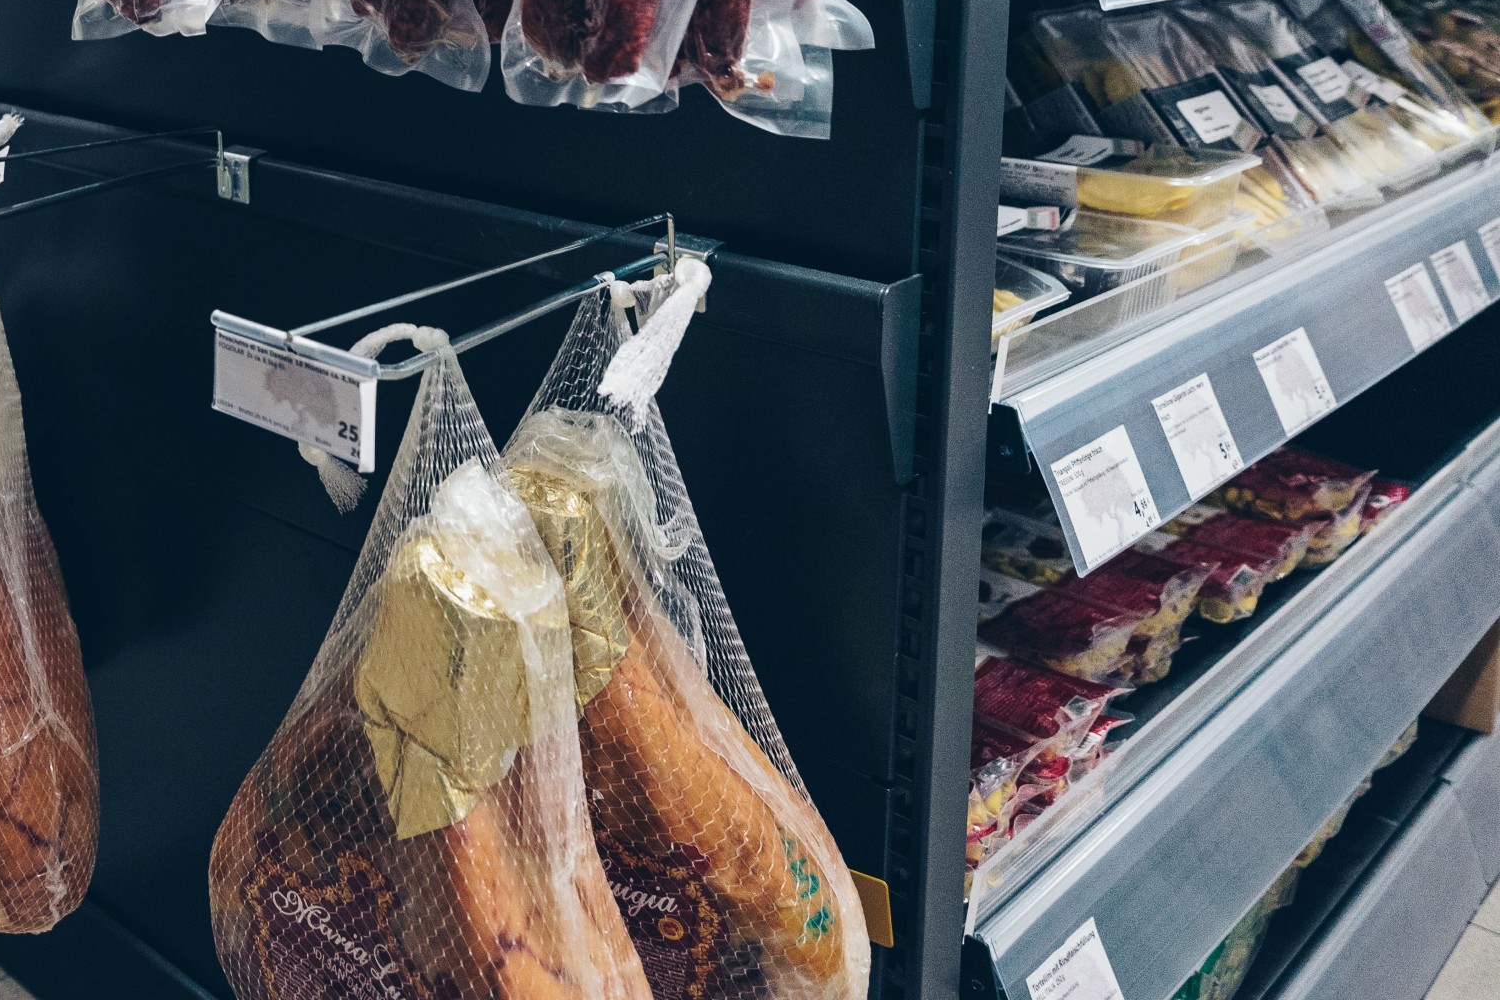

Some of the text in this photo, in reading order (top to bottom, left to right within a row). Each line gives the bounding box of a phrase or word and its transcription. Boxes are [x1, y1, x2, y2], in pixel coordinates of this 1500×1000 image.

[219, 333, 249, 349] Prosciutto
[257, 345, 268, 355] San
[269, 349, 293, 364] Daniele
[219, 341, 245, 358] FOGOLAR
[602, 859, 678, 916] uigia
[272, 890, 371, 965] Maria
